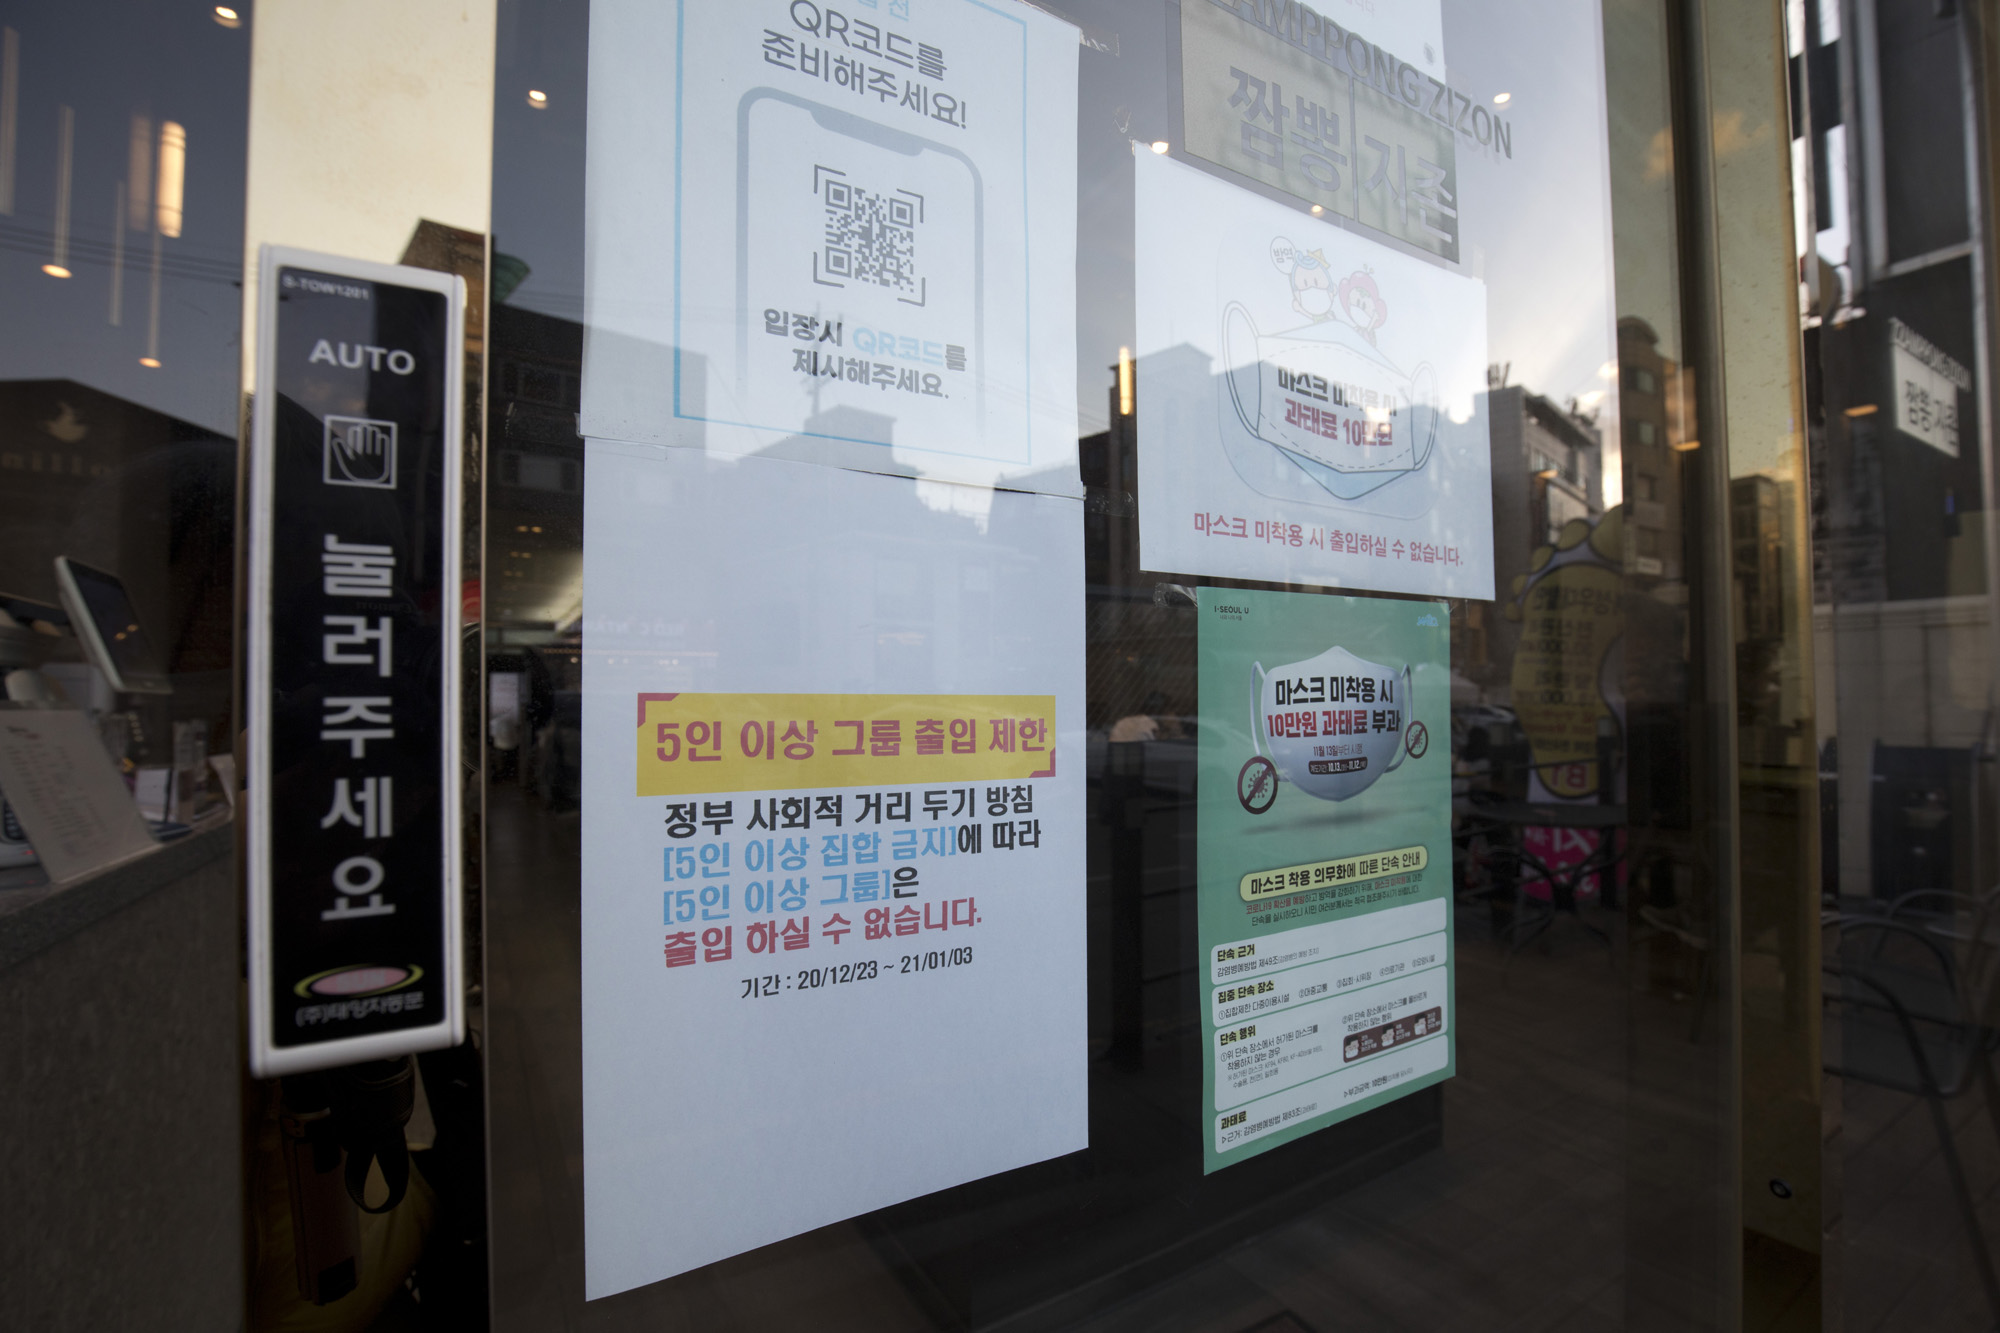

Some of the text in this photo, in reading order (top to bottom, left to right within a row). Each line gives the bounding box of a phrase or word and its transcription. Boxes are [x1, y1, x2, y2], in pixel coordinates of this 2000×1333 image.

[790, 0, 947, 81] QR코드를
[762, 28, 967, 130] 준비해주세요!
[1428, 76, 1512, 160] ZIZON
[309, 338, 415, 375] AUTO
[764, 308, 967, 372] 입장시 QR코드를
[792, 348, 949, 399] 제시해주세요.
[1278, 365, 1328, 404] 마스크
[1284, 398, 1393, 447] 과태료 10만원
[1194, 512, 1464, 567] 마스크 미착용 시 출입하실 수 없습니다.
[1275, 676, 1394, 706] 마스크 미착용 시
[321, 534, 396, 921] 눌러주세요
[656, 718, 1047, 762] 5인 이상 그룹 출입 제한
[1267, 709, 1400, 739] 10만원 과태료 부과
[664, 785, 1034, 838] 정부 사회적 거리 두기 방침
[663, 819, 1042, 881] [5인 이상 집합 금지]에 따라
[1251, 851, 1420, 895] 마스크 착용 의무화에 따른 단속 안내
[663, 867, 919, 925] [5인 이상 그룹]은
[1246, 901, 1272, 915] 코로나19
[663, 897, 982, 969] 출입 하실 수 없습니다.
[1217, 944, 1255, 962] 단속 근거
[741, 974, 781, 999] 기간
[797, 960, 878, 991] 20/12/23
[900, 947, 973, 974] 21/01/03
[1217, 961, 1257, 977] 감염병예방법
[1218, 980, 1275, 1004] 집중 단속 장소
[1253, 993, 1290, 1011] 다중이용시설
[1220, 1025, 1256, 1046] 단속 행위
[1235, 1046, 1248, 1058] 단속
[1249, 1037, 1275, 1052] 장소에서
[1275, 1031, 1294, 1045] 허가된
[1227, 1057, 1252, 1071] 착용하지
[1221, 1110, 1247, 1129] 과태료
